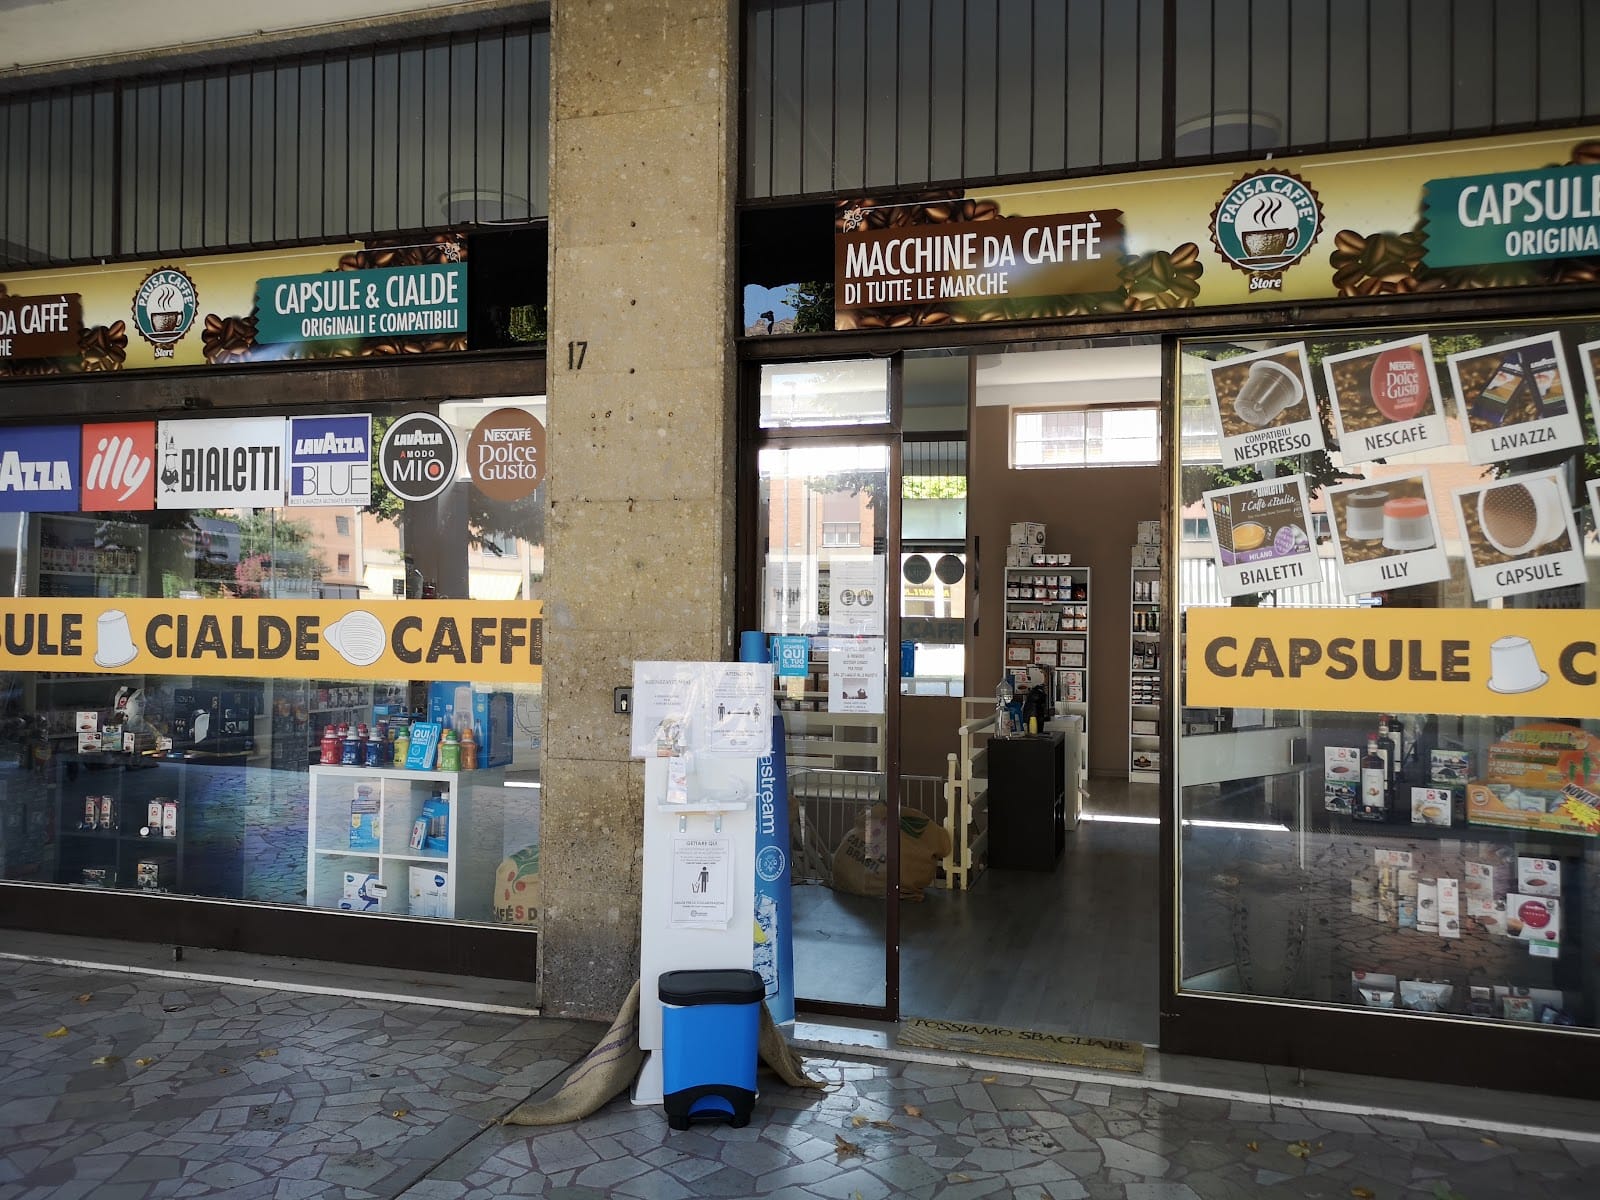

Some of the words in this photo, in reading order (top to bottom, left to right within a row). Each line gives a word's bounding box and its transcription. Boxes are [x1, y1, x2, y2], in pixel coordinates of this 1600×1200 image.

[1221, 180, 1267, 223] PAUSA
[845, 233, 976, 278] MACCHINE
[983, 236, 1015, 268] DA
[1022, 213, 1101, 265] CAFFÈ
[1505, 225, 1600, 256] ORIGINA
[139, 274, 166, 306] PAUSA
[275, 279, 360, 315] CAPSULE
[365, 283, 380, 309] &
[386, 271, 458, 308] CIALDE
[844, 283, 861, 304] DI
[866, 279, 911, 303] TUTTE
[917, 277, 935, 300] LE
[939, 272, 1008, 298] MARCHE
[1250, 277, 1281, 289] Store
[20, 296, 69, 334] CAFFÈ
[302, 315, 364, 337] ORIGINALI
[369, 314, 376, 333] E
[380, 309, 458, 333] COMPATIBILI
[155, 347, 174, 357] Store
[568, 341, 588, 370] 17
[295, 432, 365, 455] LAVAZZA
[394, 429, 443, 446] LAVAZZA
[484, 428, 531, 442] NESCAFÉ
[1234, 433, 1311, 462] NESPRESSO
[1245, 427, 1292, 445] COMPATIBILI
[1365, 425, 1427, 451] NESCAFÈ
[1490, 427, 1557, 452] LAVAZZA
[478, 444, 537, 463] Dolce
[0, 451, 72, 491] AZZA
[87, 436, 151, 501] illy
[292, 464, 369, 496] BLUE
[392, 458, 444, 481] MIO
[479, 461, 537, 481] Gusto
[1249, 550, 1273, 560] MILANO
[1240, 562, 1303, 586] BIALETTI
[1380, 562, 1408, 580] ILLY
[1496, 562, 1562, 587] CAPSULE
[0, 613, 82, 656] ULE
[145, 613, 320, 662] CIALDE
[783, 649, 804, 659] QUI
[1204, 636, 1470, 682] CAPSULE
[1559, 641, 1596, 686] C
